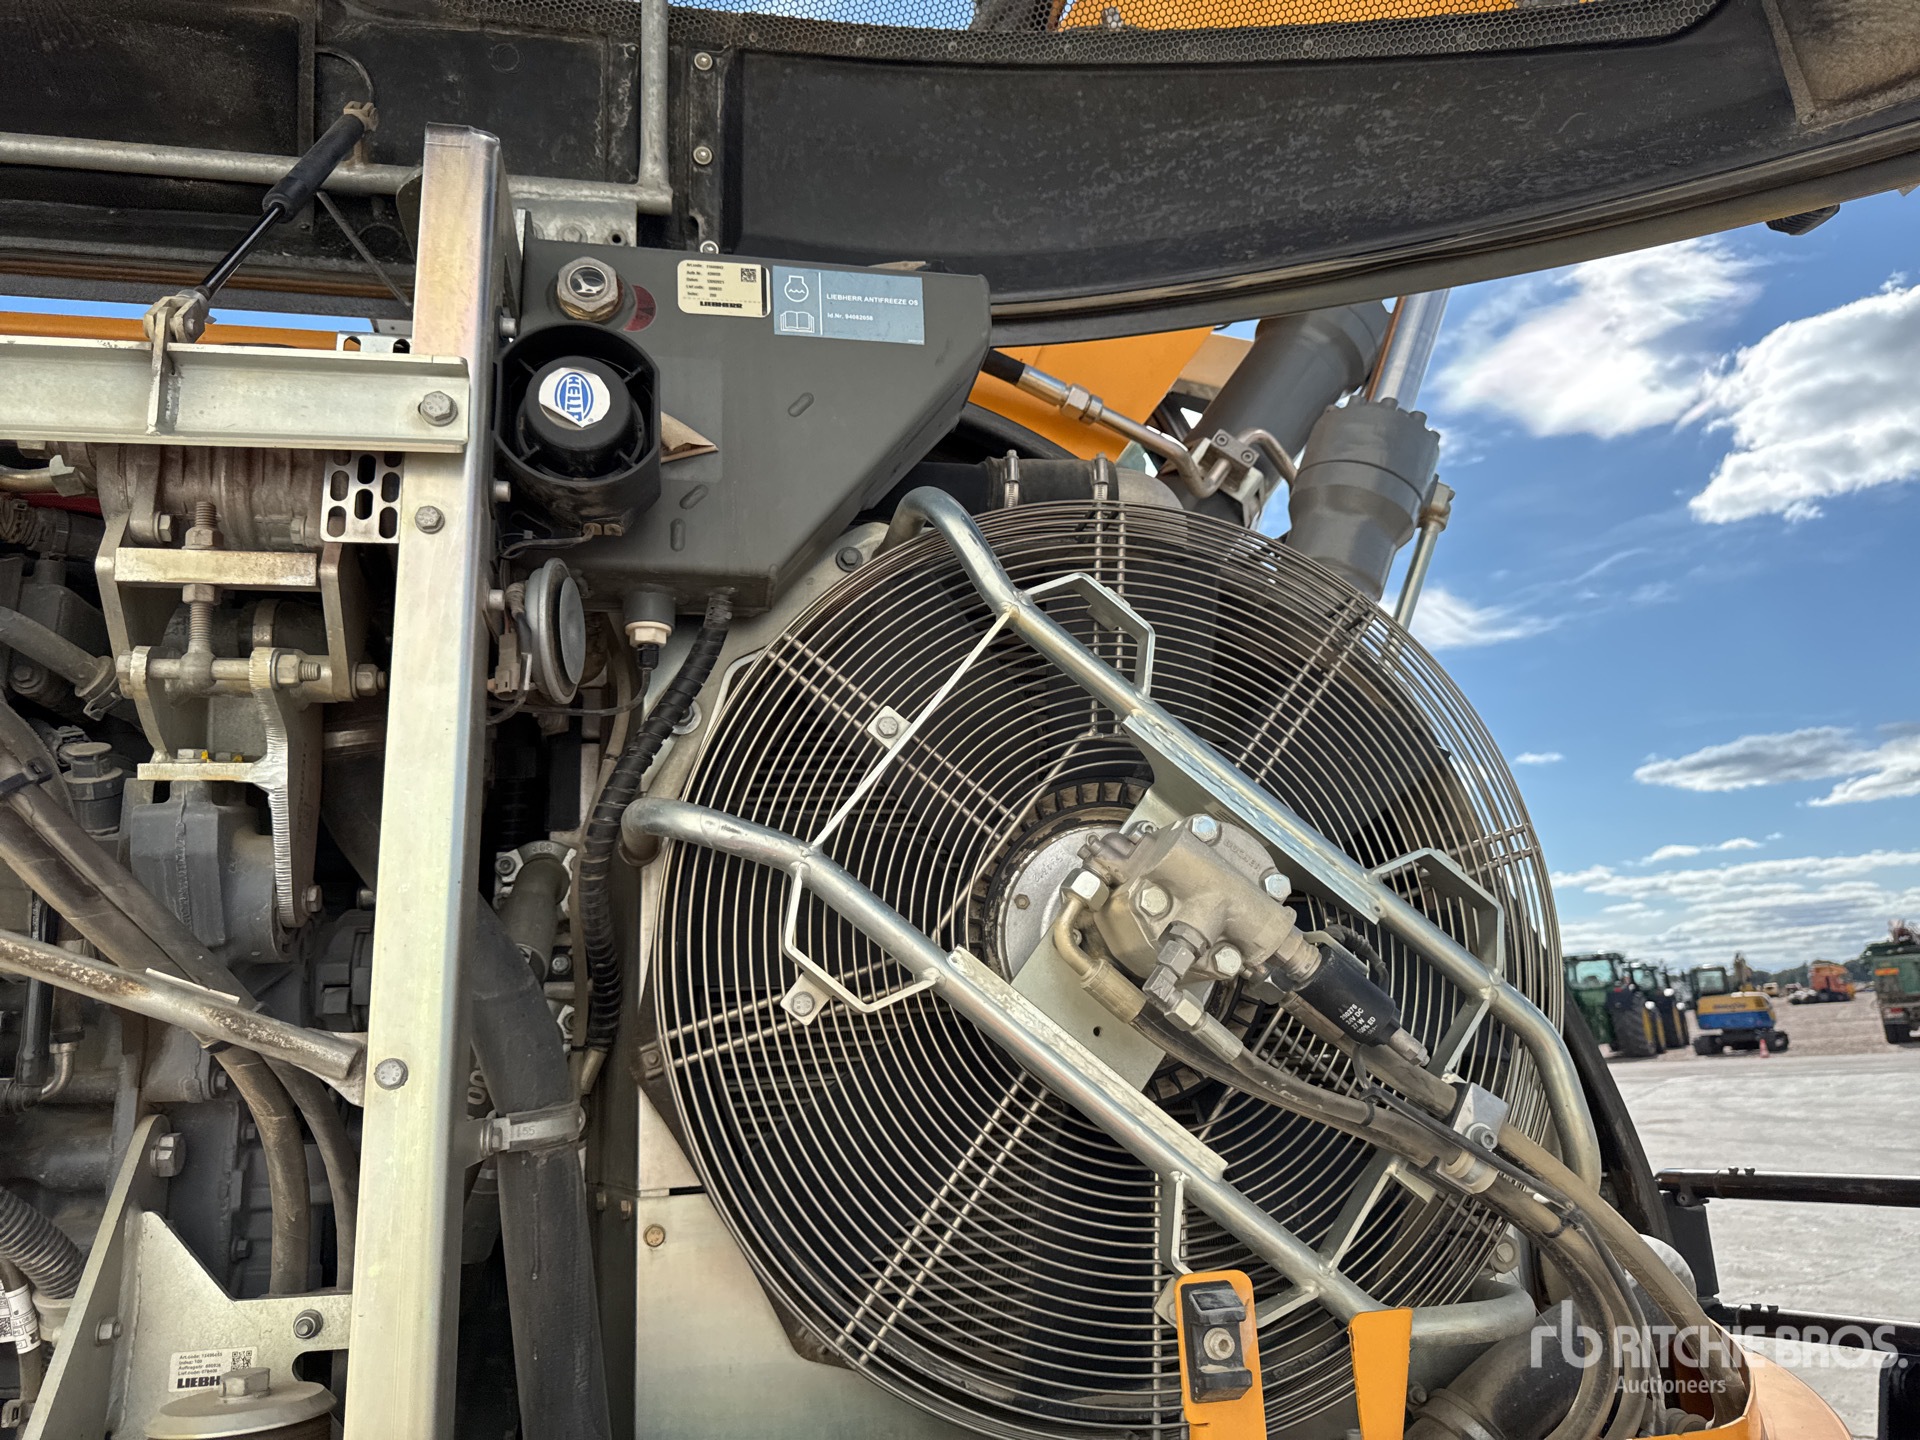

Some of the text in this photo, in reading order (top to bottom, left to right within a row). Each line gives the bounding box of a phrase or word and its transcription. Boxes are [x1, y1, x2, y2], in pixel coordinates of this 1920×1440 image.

[826, 293, 863, 303] LIEBHERR
[864, 295, 907, 306] ANTIFREEZE
[1354, 1007, 1364, 1018] DC
